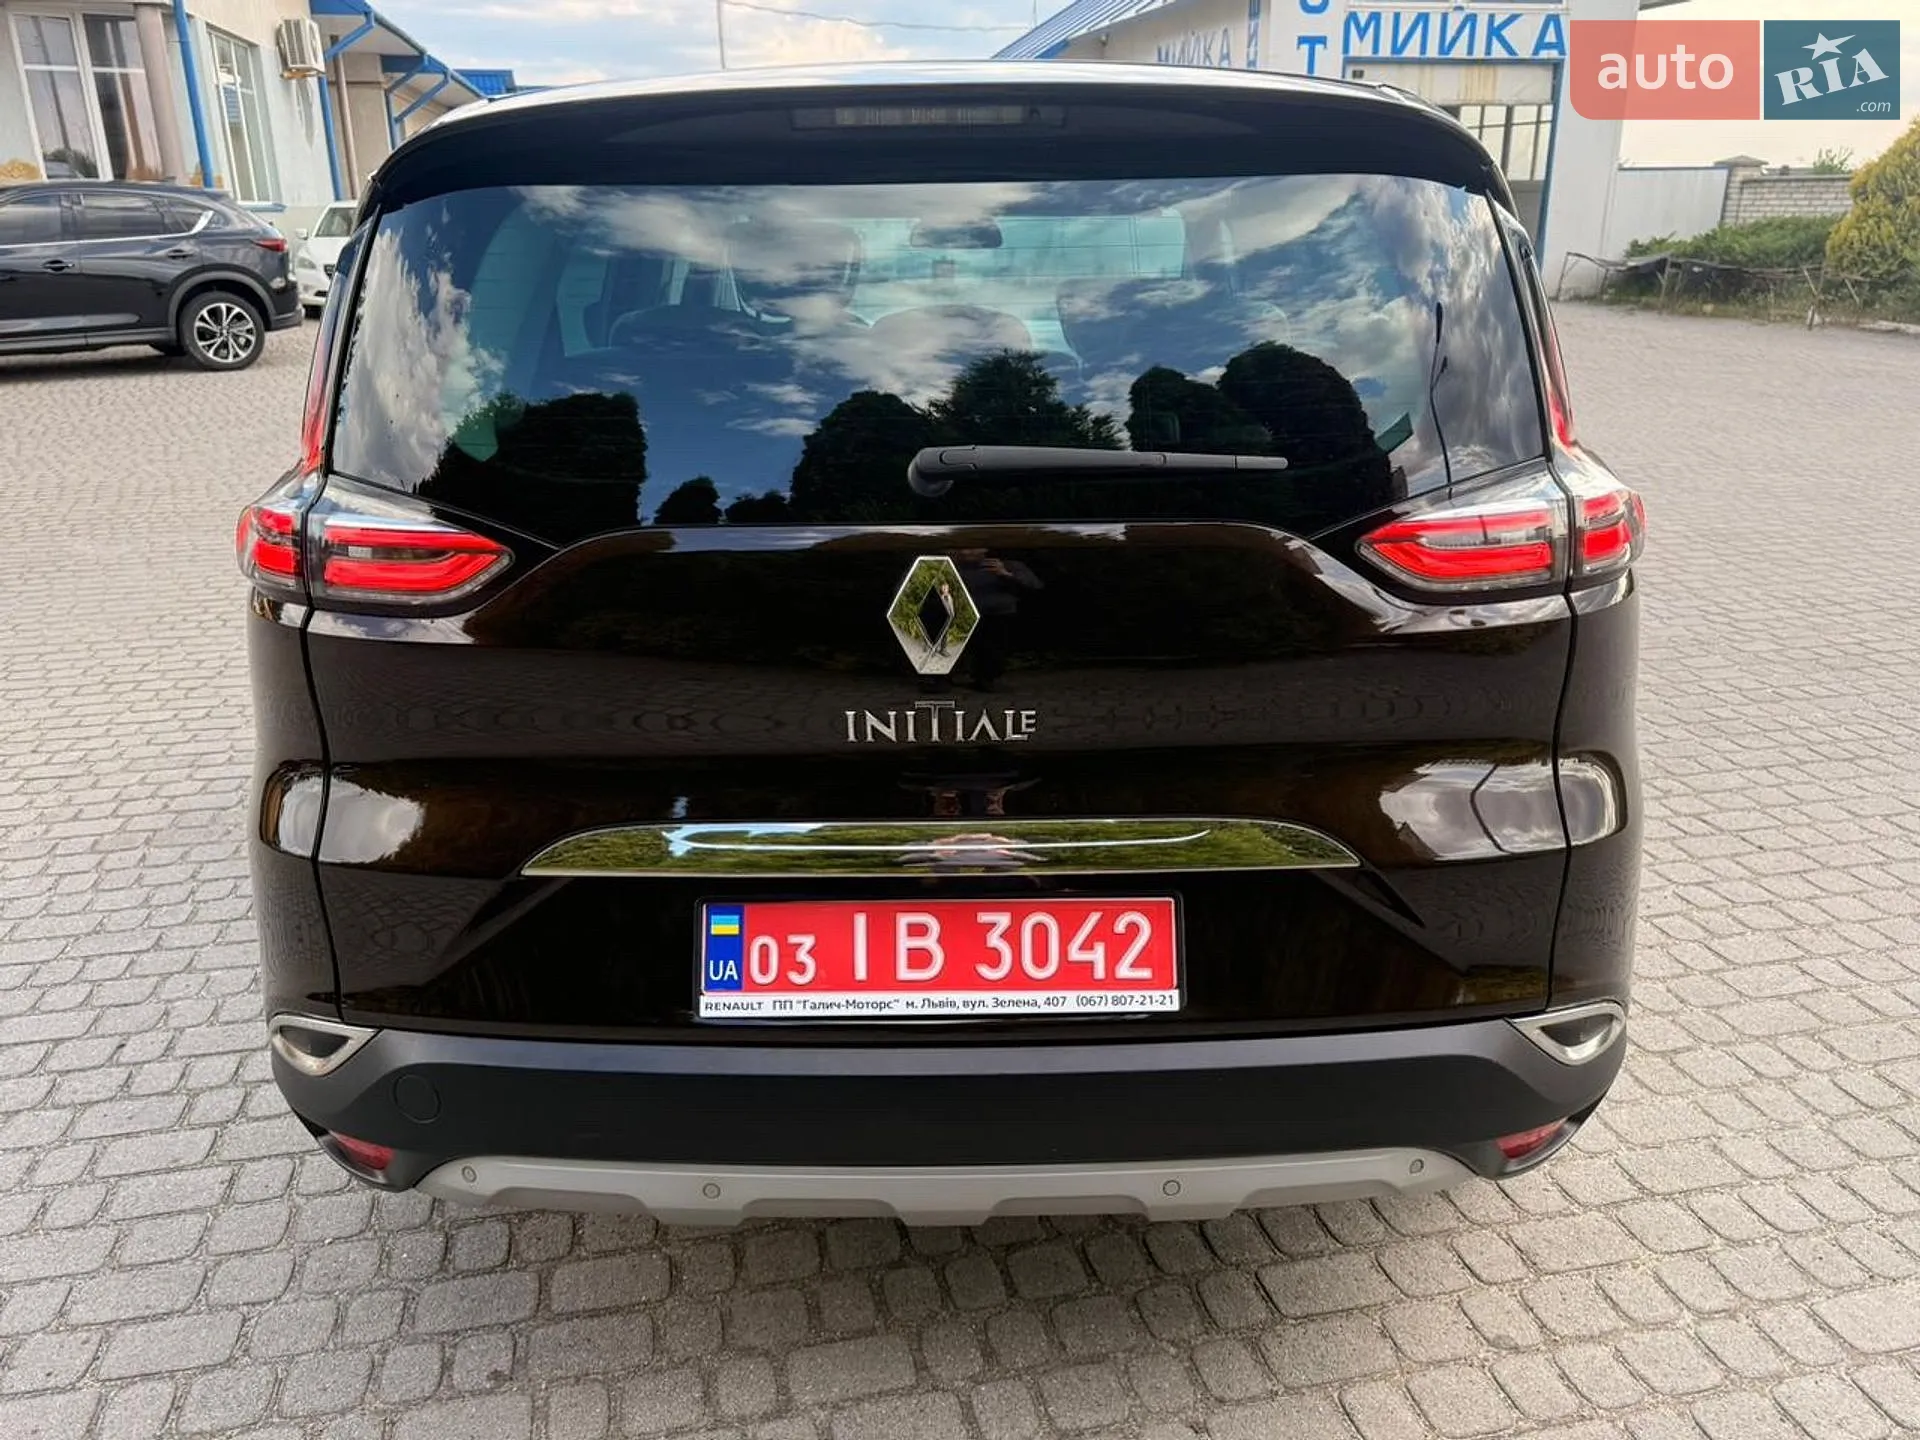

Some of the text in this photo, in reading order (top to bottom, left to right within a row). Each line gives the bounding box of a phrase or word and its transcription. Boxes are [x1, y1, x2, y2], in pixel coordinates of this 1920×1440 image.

[1342, 6, 1567, 56] МИЙКА
[845, 701, 1036, 742] INITIALE
[749, 935, 818, 985] 03
[974, 911, 1155, 982] 3042
[709, 960, 739, 982] UA
[704, 1001, 764, 1011] RENAULT
[772, 1000, 793, 1011] ПП
[962, 999, 989, 1011] вул.
[991, 998, 1040, 1010] Зелена,
[1043, 996, 1066, 1007] 407
[1076, 995, 1109, 1008] (067)
[1111, 994, 1174, 1006] 807-21-21
